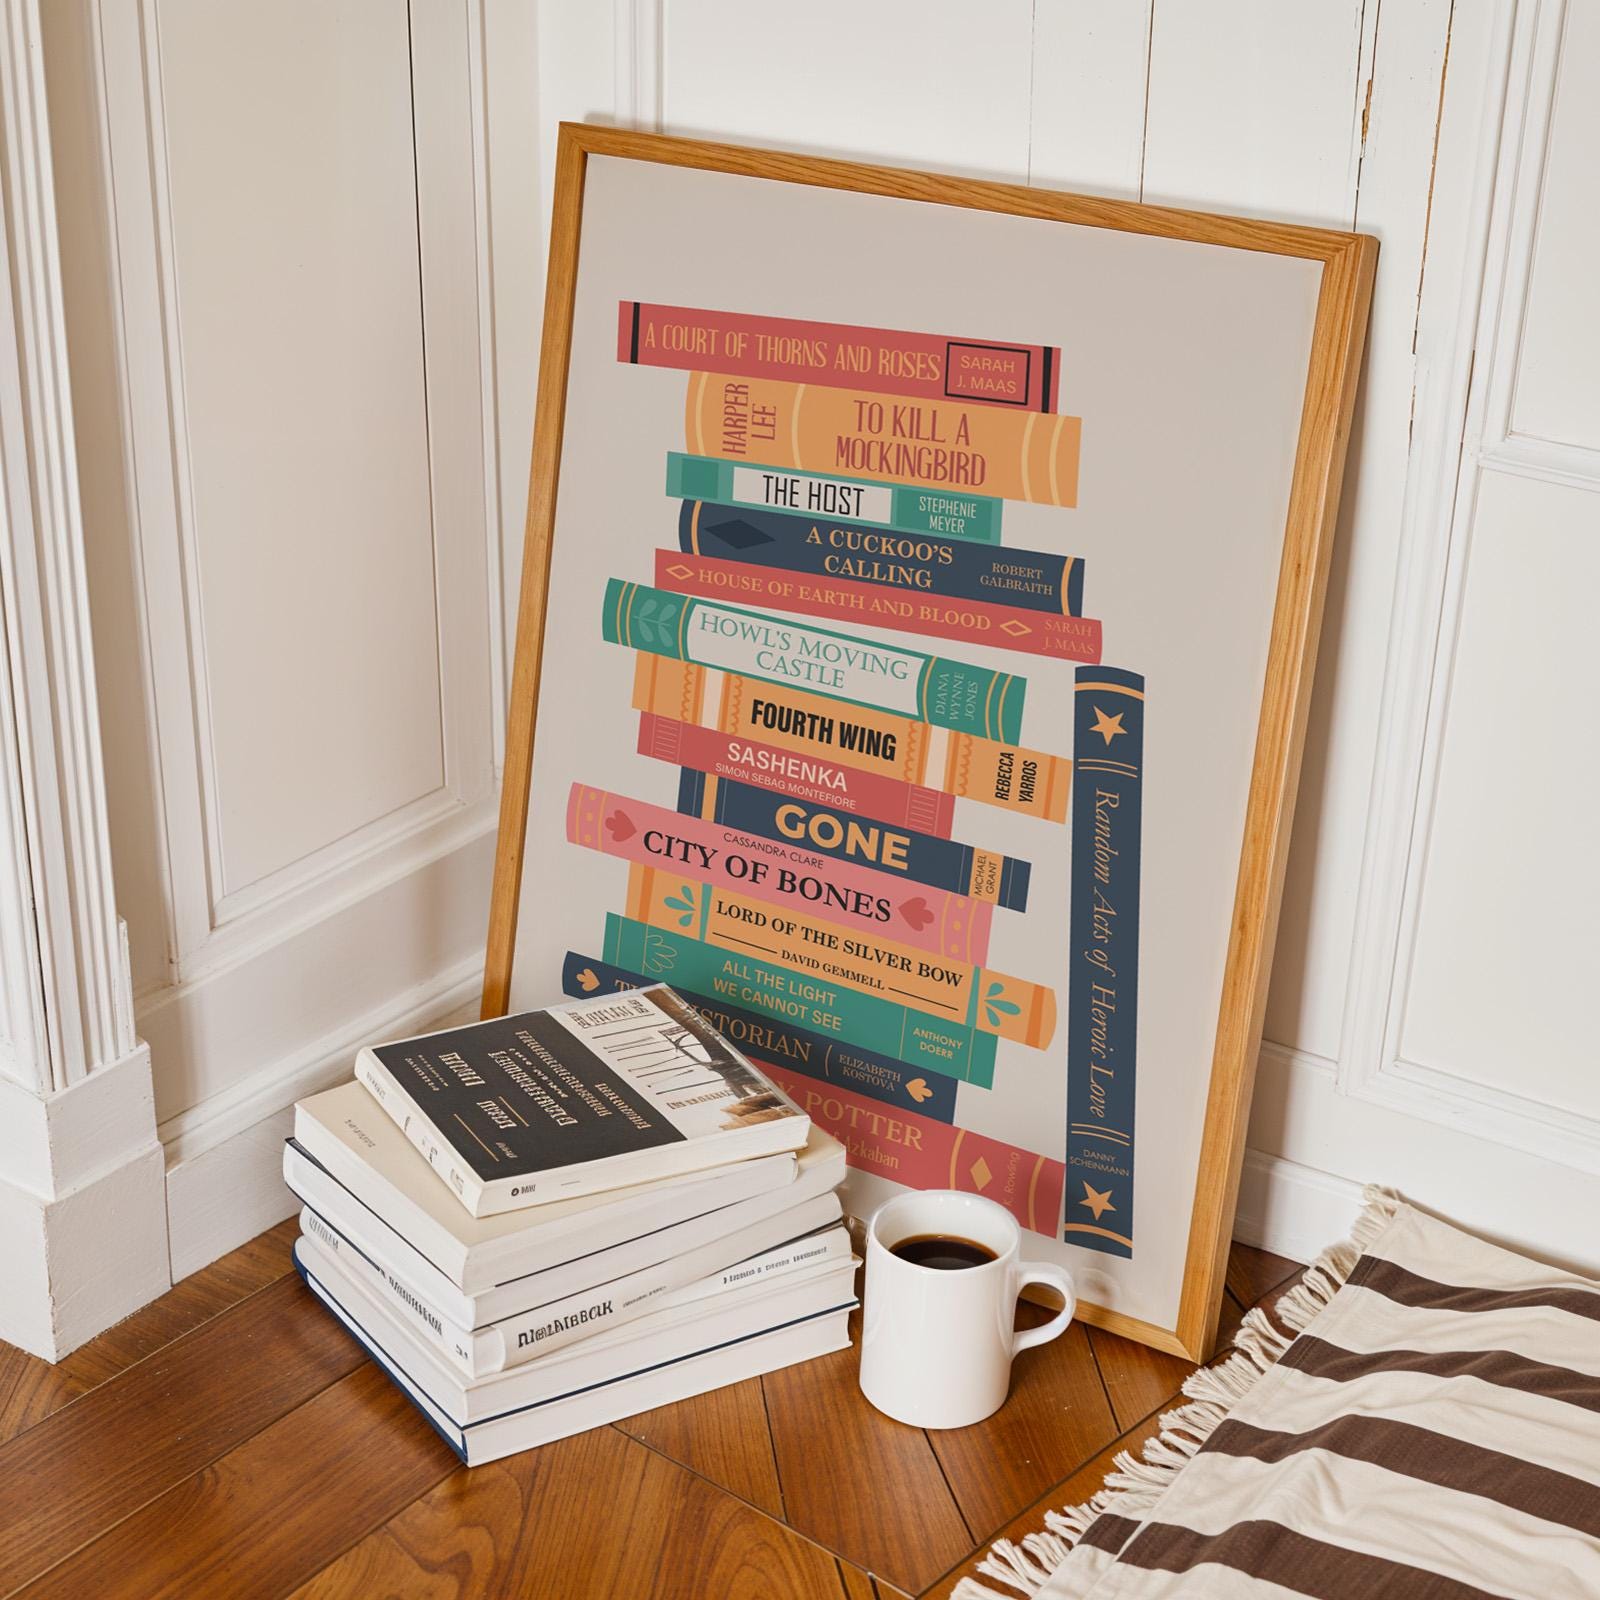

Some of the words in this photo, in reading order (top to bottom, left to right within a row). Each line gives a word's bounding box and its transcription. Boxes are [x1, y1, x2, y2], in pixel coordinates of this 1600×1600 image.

[645, 323, 656, 348] A
[662, 324, 718, 355] COURT
[725, 332, 749, 358] OF
[756, 334, 828, 368] THORNS
[834, 344, 871, 374] AND
[878, 348, 941, 380] ROSES
[960, 355, 1014, 373] SARAH
[970, 377, 1016, 394] MAAS
[722, 383, 748, 454] HARPER
[751, 403, 777, 440] LEE
[854, 400, 882, 434] TO
[892, 404, 946, 443] KILL
[954, 414, 970, 446] A
[836, 436, 986, 486] MOCKINGBIRD
[763, 474, 799, 509] THE
[808, 482, 864, 516] HOST
[919, 496, 976, 518] STEPHENIE
[806, 526, 822, 545] A
[830, 529, 953, 565] CUCKOO'S
[929, 516, 964, 534] MEYER
[824, 556, 932, 589] CALLING
[980, 575, 1052, 596] GALBRAITH
[992, 562, 1043, 580] ROBERT
[698, 569, 762, 594] HOUSE
[767, 580, 794, 598] OF
[798, 586, 864, 610] EARTH
[870, 596, 914, 617] AND
[919, 604, 991, 631] BLOOD
[700, 612, 791, 650] HOWL'S
[798, 637, 909, 680] MOVING
[1045, 619, 1092, 638] SARAH
[1054, 637, 1094, 655] MAAS
[757, 652, 844, 690] CASTLE
[936, 673, 950, 716] DIANA
[948, 672, 965, 720] WYNNE
[964, 681, 978, 720] JONES
[751, 699, 834, 743] FOURTH
[840, 722, 896, 762] WING
[715, 762, 748, 779] SIMON
[751, 771, 784, 788] SEBAG
[786, 780, 856, 810] MONTEFIORE
[728, 742, 848, 792] SASHENKA
[994, 752, 1014, 800] REBECCA
[1018, 760, 1037, 802] YARROS
[723, 832, 787, 860] CASSANDRA
[790, 850, 824, 870] CLARE
[775, 804, 910, 871] GONE
[1095, 788, 1120, 884] Random
[643, 831, 718, 869] CITY
[725, 855, 769, 884] OF
[776, 868, 891, 923] BONES
[974, 855, 987, 896] MICHAEL
[985, 861, 997, 894] GRANT
[1093, 886, 1118, 943] Acts
[716, 901, 767, 928] LORD
[772, 916, 796, 934] OF
[801, 926, 839, 951] THE
[842, 940, 912, 973] SILVER
[918, 960, 962, 988] BOW
[1084, 949, 1116, 978] of
[722, 960, 752, 980] ALL
[755, 969, 785, 990] THE
[788, 978, 837, 1007] LIGHT
[782, 950, 819, 969] DAVID
[822, 962, 884, 990] GEMMELL
[713, 978, 739, 996] WE
[742, 986, 808, 1020] CANNOT
[810, 1010, 842, 1031] SEE
[1091, 981, 1116, 1059] Heroic
[692, 1004, 811, 1064] STORIAN
[912, 1026, 963, 1050] ANTHONY
[920, 1042, 954, 1060] DOERR
[838, 1054, 900, 1082] ELIZABETH
[842, 1067, 895, 1092] KOSTOVA
[1090, 1062, 1114, 1118] Love
[804, 1090, 922, 1150] POTTER
[1083, 1150, 1116, 1162] DANNY
